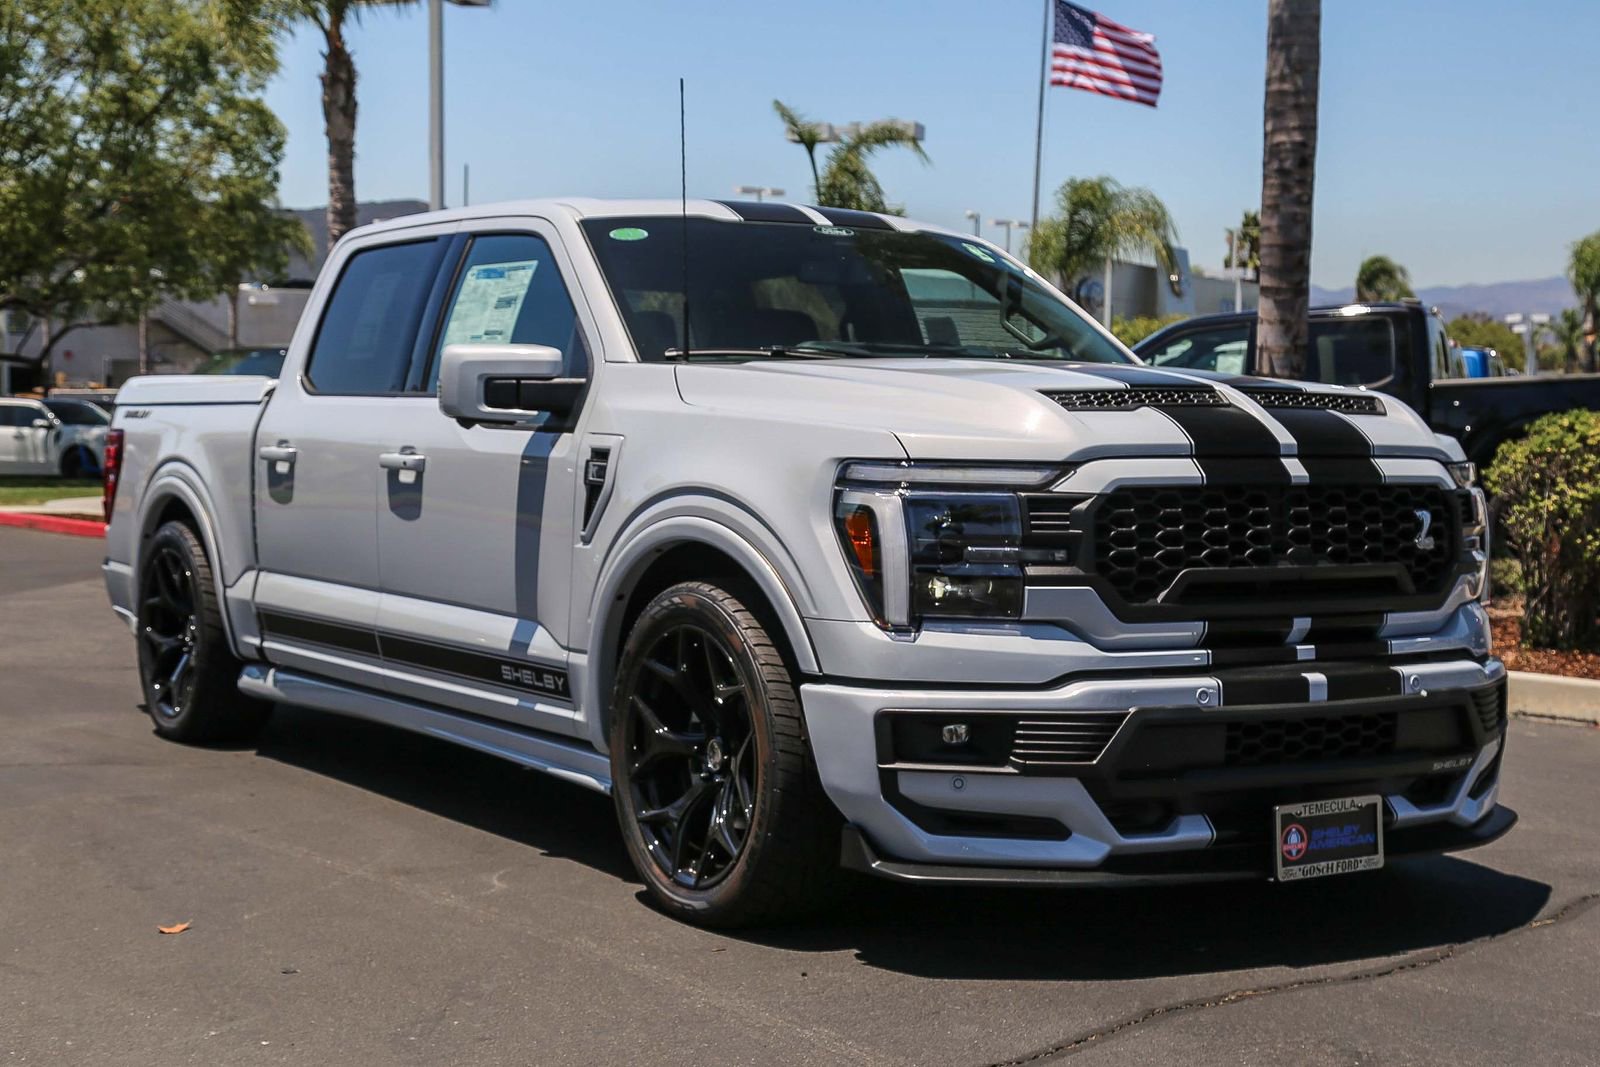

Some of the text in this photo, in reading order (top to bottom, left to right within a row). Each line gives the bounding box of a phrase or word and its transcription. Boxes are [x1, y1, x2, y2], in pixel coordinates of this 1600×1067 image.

[501, 665, 564, 690] SHELBY
[1433, 758, 1473, 770] SHELBY
[1302, 799, 1356, 815] TEMECULA
[1312, 824, 1360, 839] SHELBY
[1308, 833, 1375, 849] AMERICAN
[1336, 859, 1358, 872] FORD
